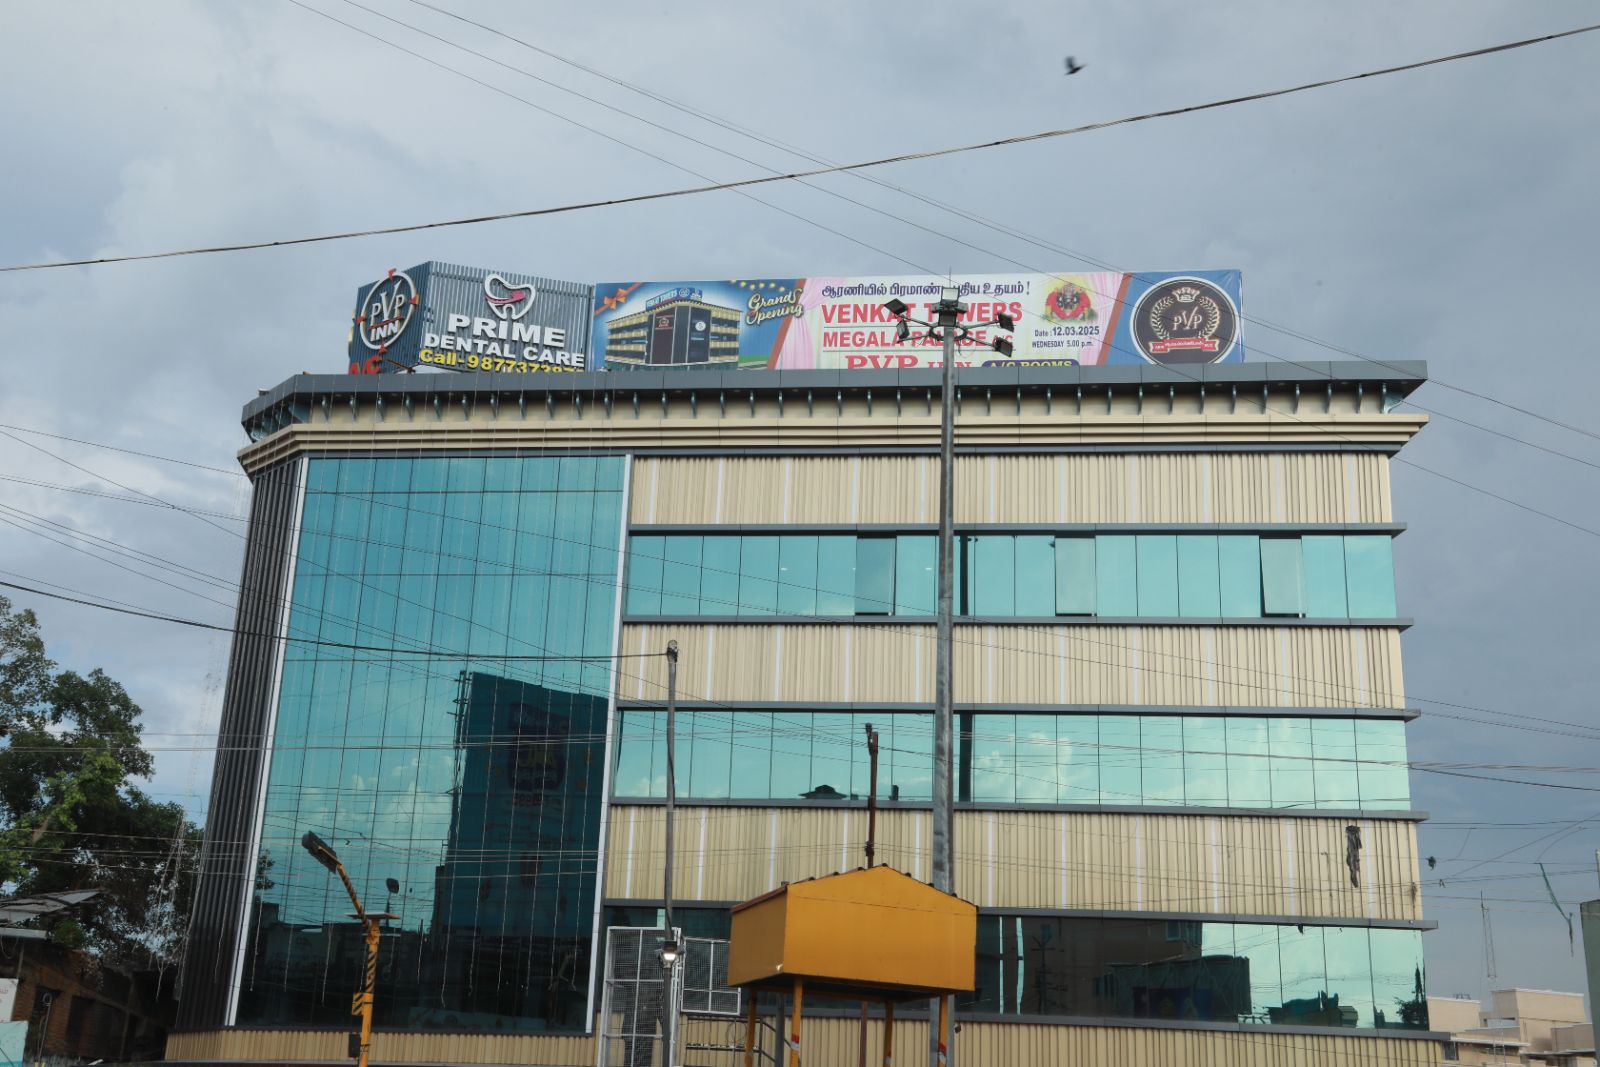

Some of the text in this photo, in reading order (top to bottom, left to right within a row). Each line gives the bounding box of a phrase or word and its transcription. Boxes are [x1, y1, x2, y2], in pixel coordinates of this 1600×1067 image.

[748, 288, 803, 311] Grand
[821, 283, 887, 299] ஆரணியில்
[889, 282, 942, 297] பிரமாண்
[370, 279, 405, 328] PVP
[746, 304, 803, 325] Opening
[924, 301, 1023, 323] TWERS
[1173, 306, 1203, 331] PVP
[370, 320, 401, 342] INN
[448, 313, 566, 348] PRIME
[823, 331, 905, 348] MEGALA
[1034, 329, 1049, 337] Date
[1053, 325, 1099, 336] 12.03.2025
[424, 333, 585, 368] DENTAL CARE
[1032, 340, 1065, 349] WEDNESDAY
